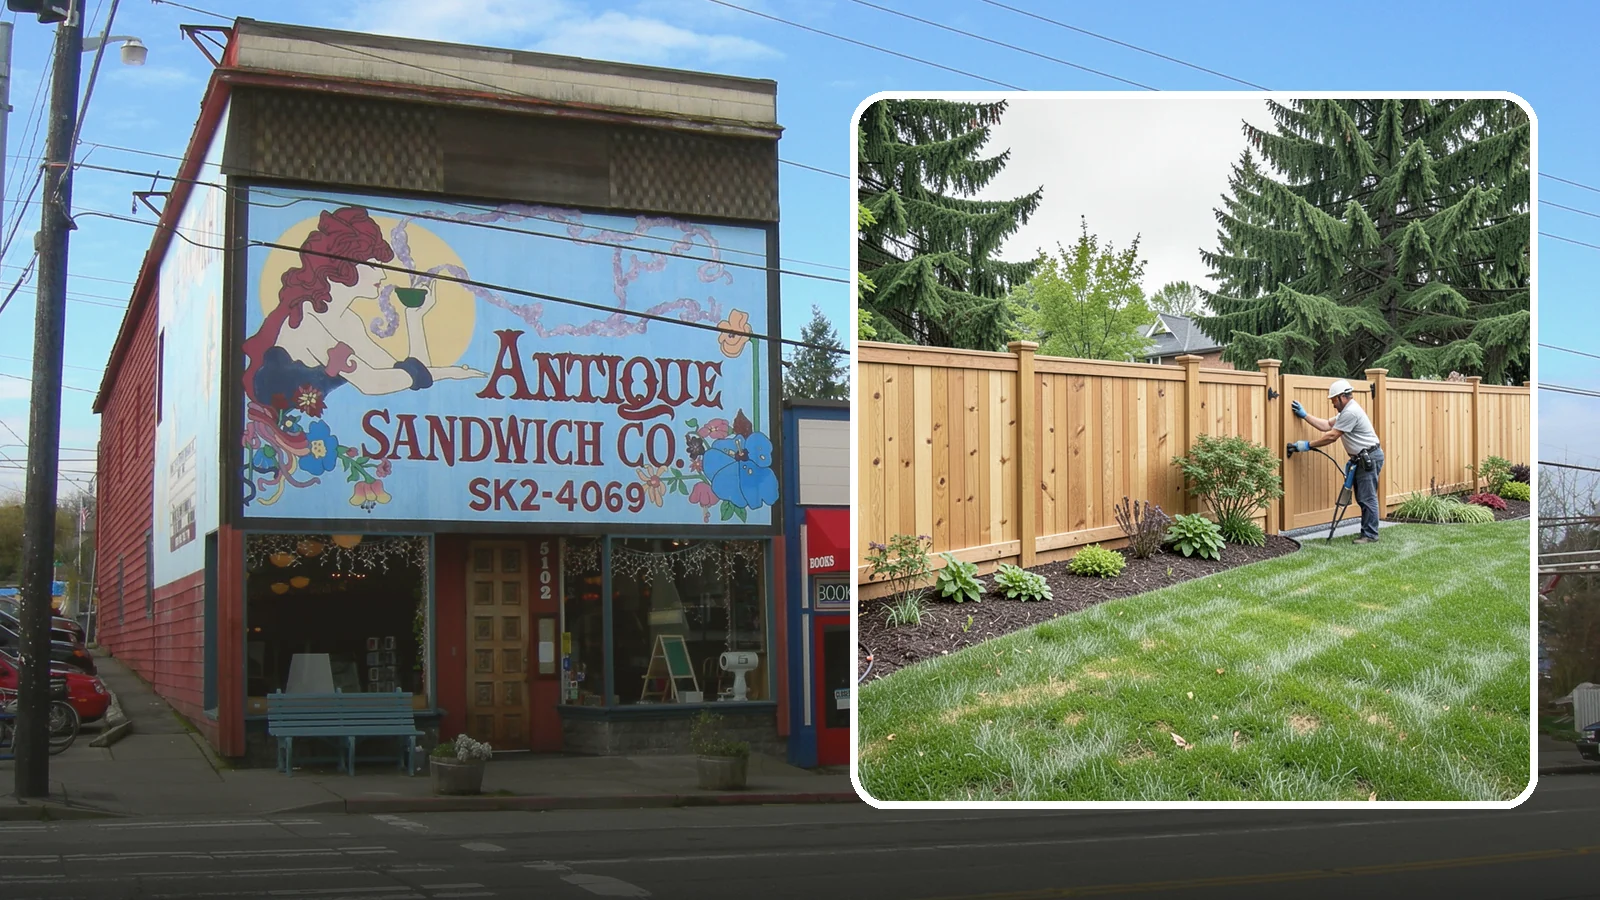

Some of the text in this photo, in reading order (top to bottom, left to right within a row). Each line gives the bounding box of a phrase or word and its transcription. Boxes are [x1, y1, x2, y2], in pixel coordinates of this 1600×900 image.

[476, 329, 723, 421] ANTIQUE
[361, 409, 685, 468] SANDWICH CO.
[469, 479, 646, 513] SK2-4069
[540, 542, 551, 599] 5102
[809, 555, 835, 568] BOOKS
